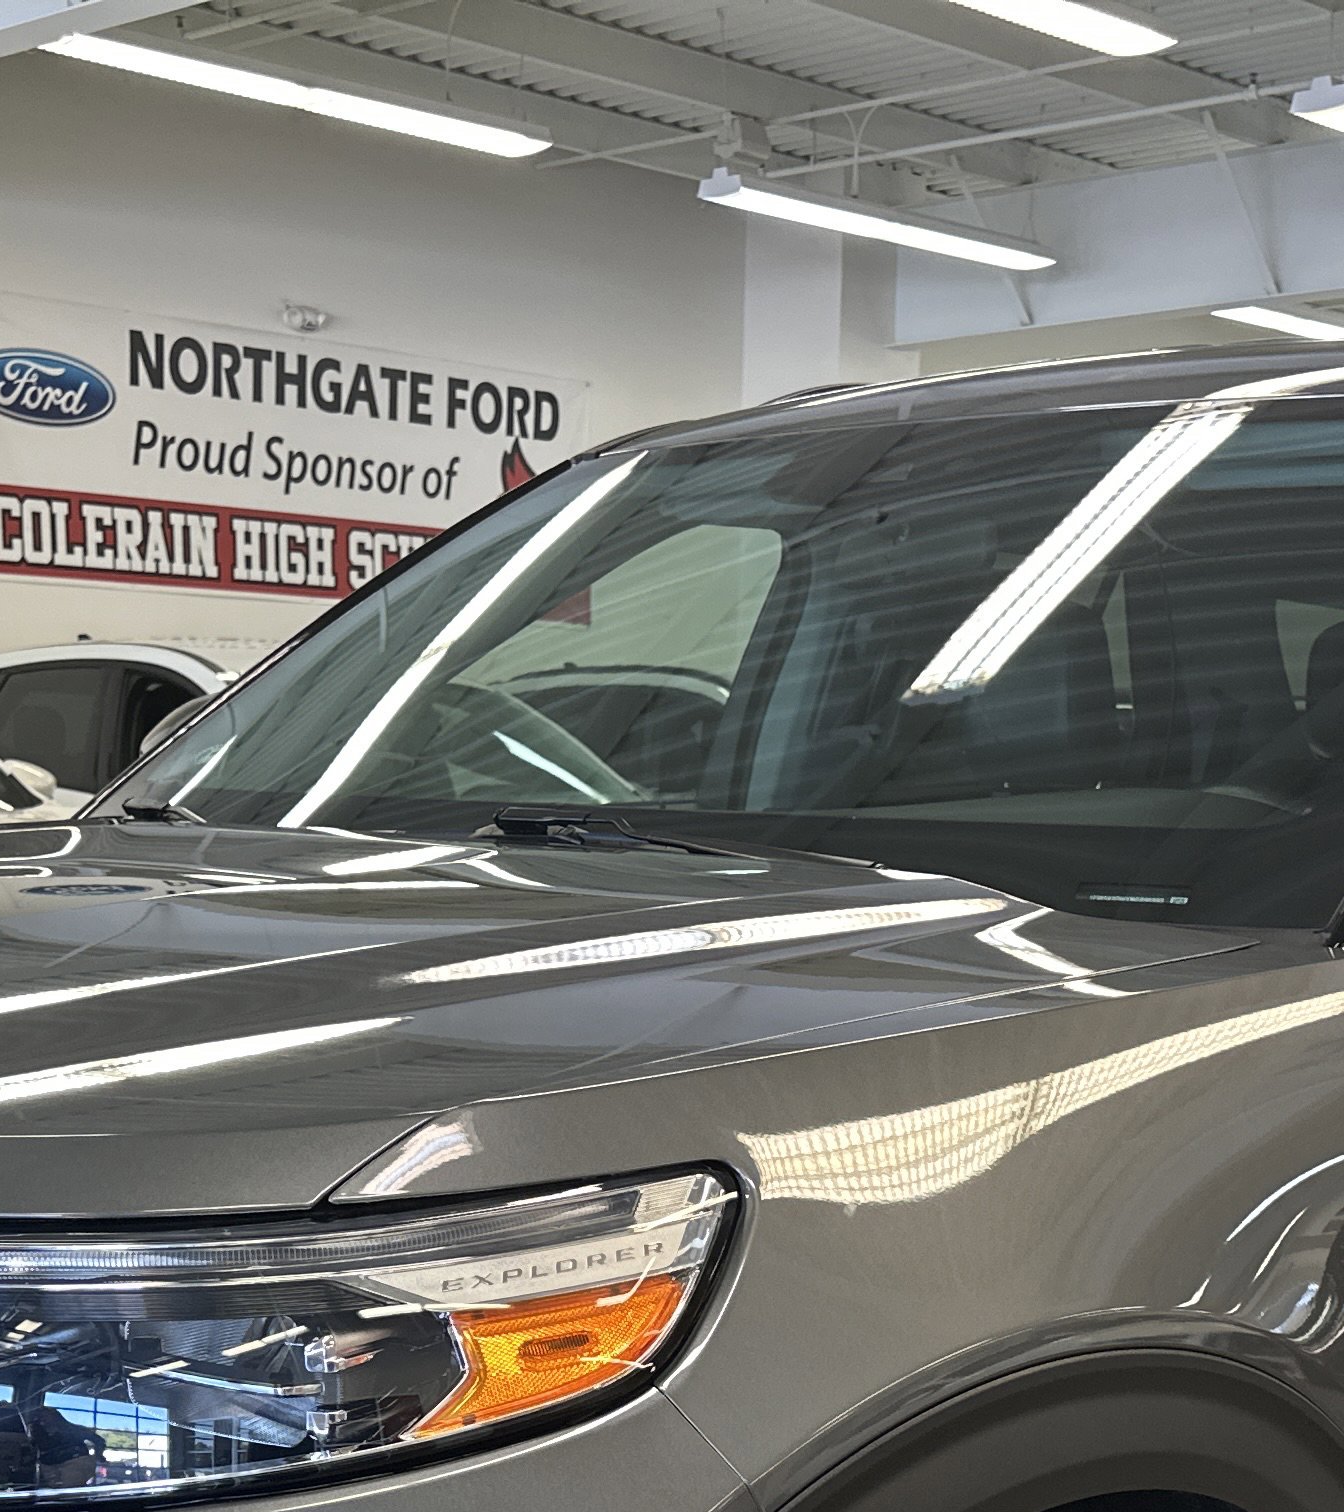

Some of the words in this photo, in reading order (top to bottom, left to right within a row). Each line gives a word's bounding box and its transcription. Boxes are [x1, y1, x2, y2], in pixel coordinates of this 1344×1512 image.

[129, 329, 433, 426] NORTHGATE
[447, 377, 559, 441] FORD
[133, 420, 254, 478] Proud
[262, 436, 414, 494] Sponsor
[422, 456, 460, 500] of
[231, 516, 338, 589] HIGH
[441, 1242, 663, 1293] EXPLORER
